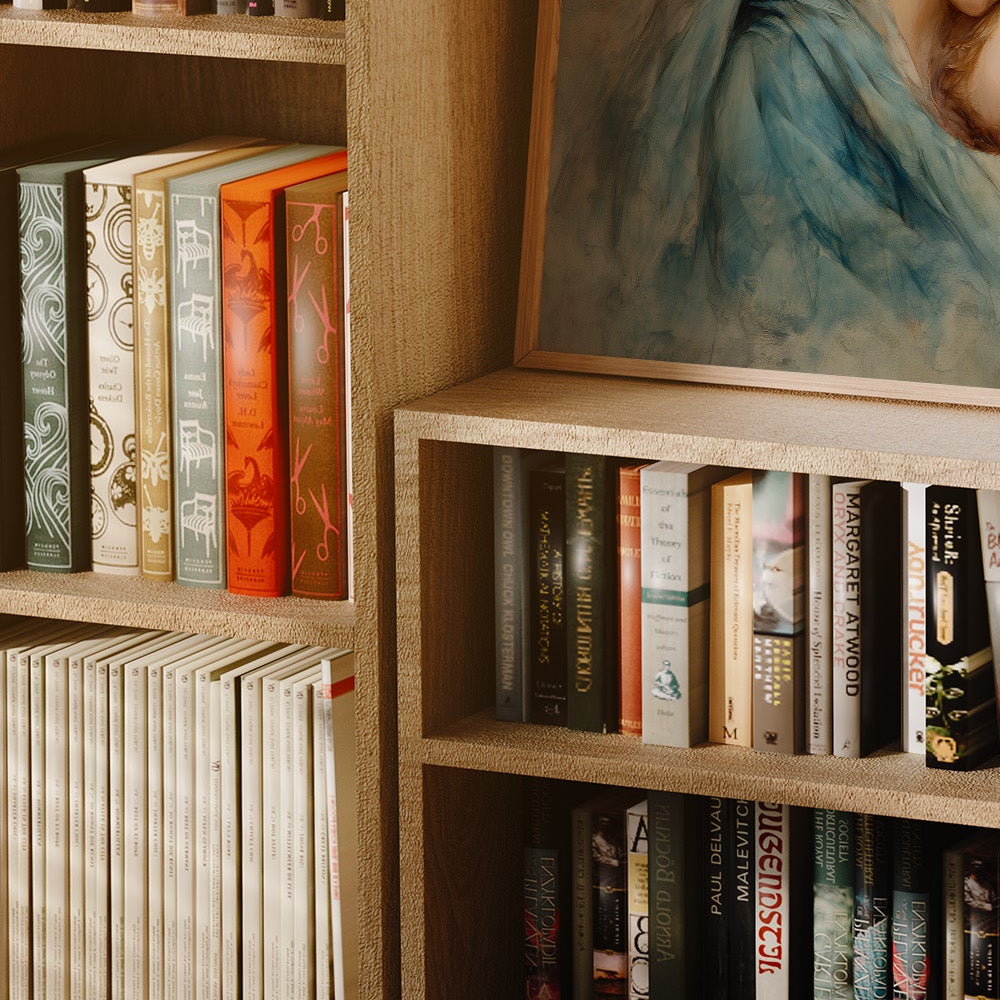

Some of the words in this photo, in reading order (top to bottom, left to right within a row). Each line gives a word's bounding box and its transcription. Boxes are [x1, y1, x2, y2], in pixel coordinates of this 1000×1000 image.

[502, 455, 515, 527] DOWNTOWN
[660, 503, 672, 513] of
[650, 536, 682, 550] Theory
[833, 491, 847, 546] ORYX
[502, 531, 515, 558] OWL
[845, 492, 861, 607] MARGARET
[502, 564, 515, 606] CHUCK
[833, 548, 847, 594] AND
[502, 609, 515, 692] KLOSTERMAN
[833, 599, 847, 671] CRAKE
[845, 610, 861, 698] ATWOOD
[722, 726, 738, 741] M
[710, 799, 722, 865] DELVAU
[710, 870, 723, 916] PAUL
